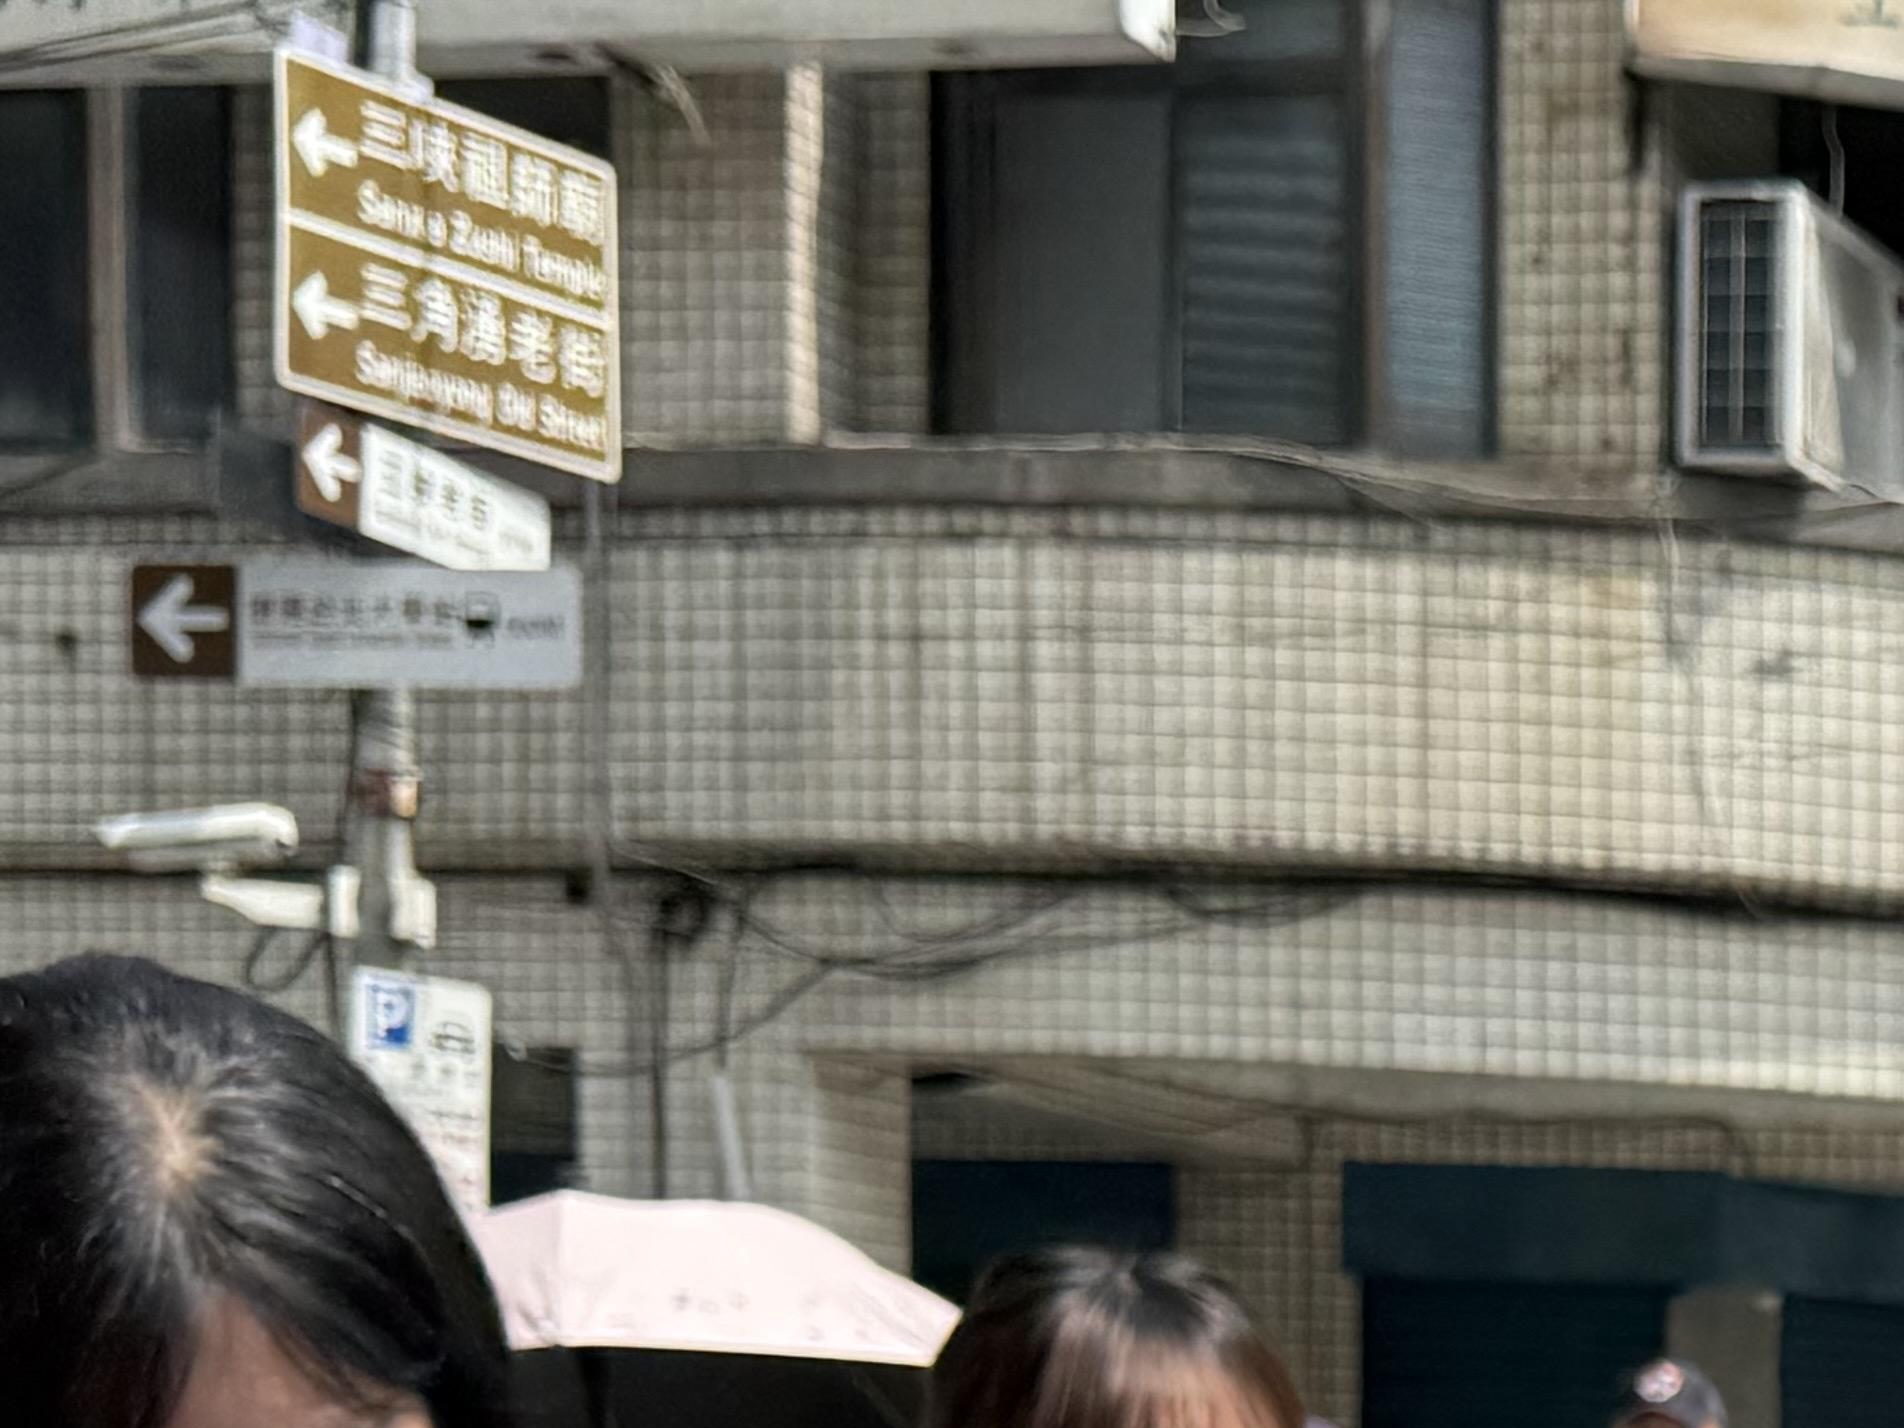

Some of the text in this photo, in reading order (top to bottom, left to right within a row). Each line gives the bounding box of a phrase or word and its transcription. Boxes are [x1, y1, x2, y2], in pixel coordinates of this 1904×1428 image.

[359, 99, 606, 246] 三峽祖師廟
[360, 263, 606, 398] 三角湧老街
[523, 233, 607, 299] Temple
